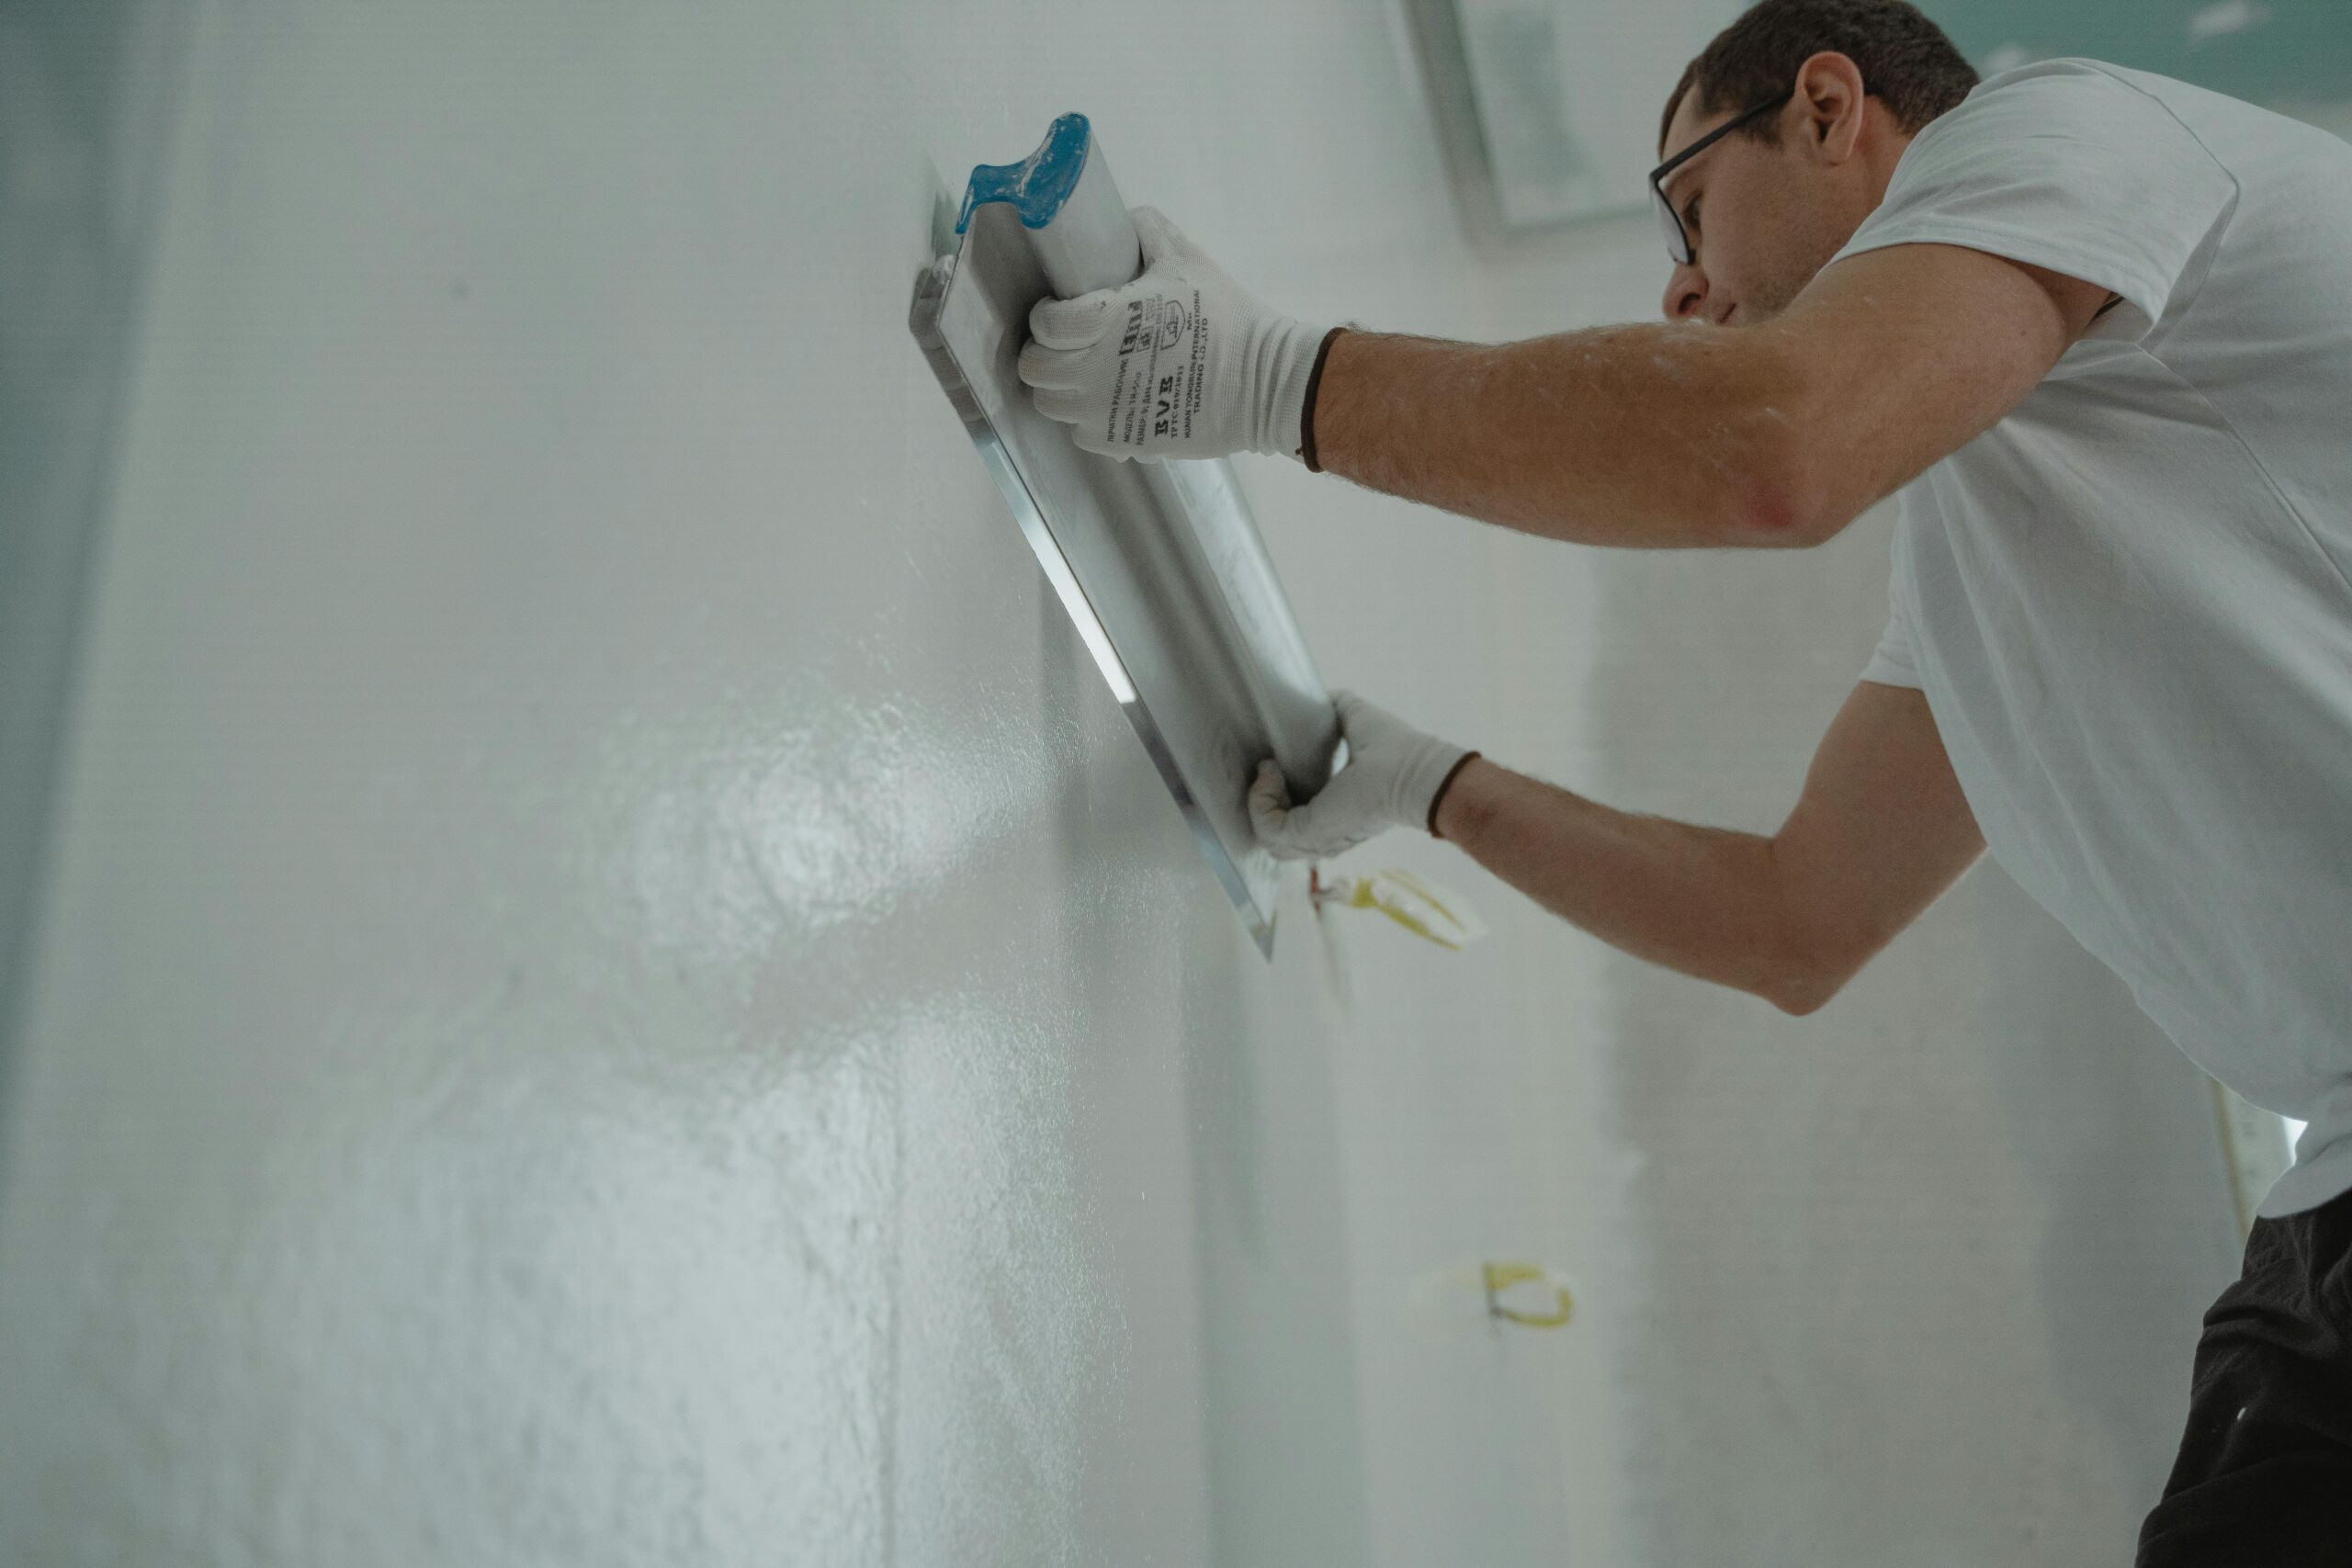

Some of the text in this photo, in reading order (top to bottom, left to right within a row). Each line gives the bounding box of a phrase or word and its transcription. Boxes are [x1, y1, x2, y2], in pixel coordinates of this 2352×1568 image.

[1191, 288, 1200, 360] INTERNATIONAL
[1193, 364, 1204, 414] TRADING
[1107, 408, 1118, 442] ПЕРЧАТКИ
